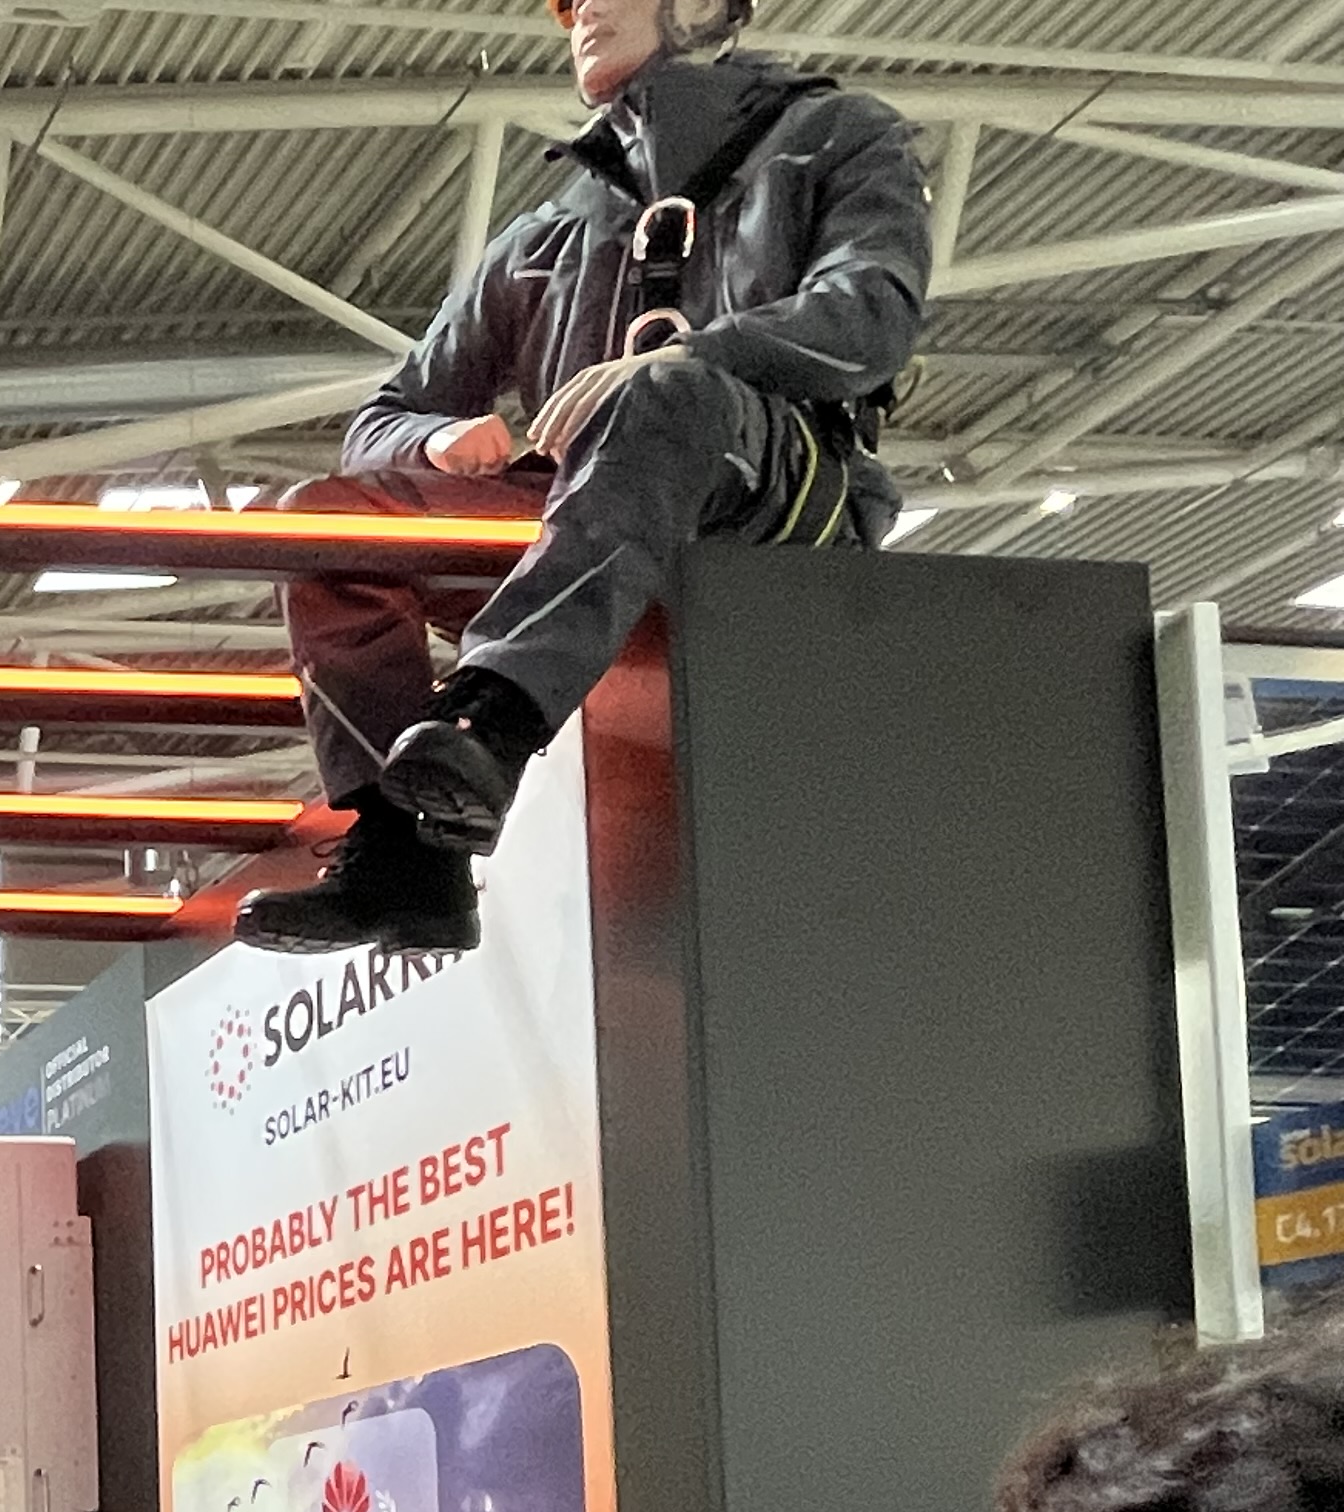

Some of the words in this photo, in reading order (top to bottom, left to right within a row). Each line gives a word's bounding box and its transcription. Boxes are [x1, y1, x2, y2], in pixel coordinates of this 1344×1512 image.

[264, 1046, 411, 1146] SOLAR-KIT.EU
[168, 1293, 265, 1364] HUAWEI
[273, 1255, 376, 1331] PRICES
[384, 1227, 452, 1296] ARE
[461, 1182, 576, 1270] HERE!
[201, 1195, 339, 1288] PROBABLY
[346, 1166, 411, 1231] THE
[419, 1122, 511, 1206] BEST
